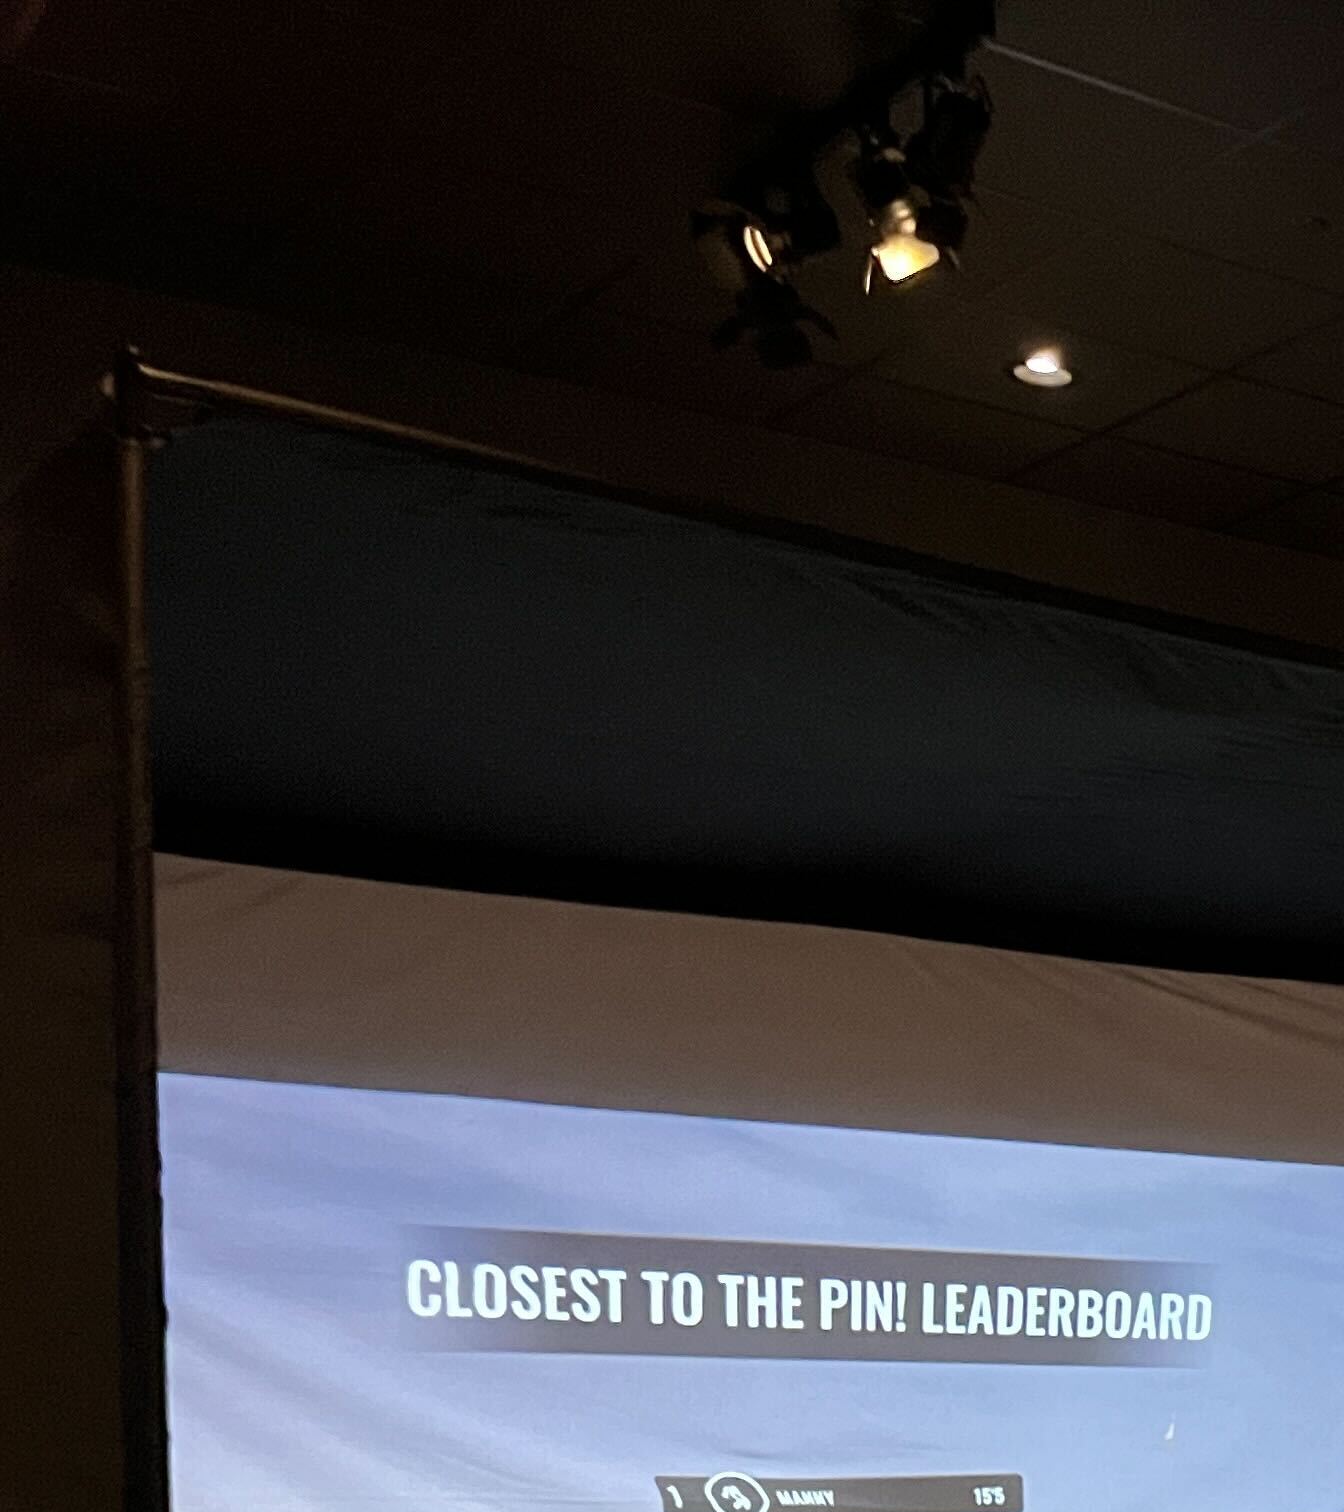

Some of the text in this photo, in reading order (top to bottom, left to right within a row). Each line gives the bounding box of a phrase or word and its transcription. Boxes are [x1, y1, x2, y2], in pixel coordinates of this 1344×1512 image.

[406, 1258, 1212, 1342] CLOSEST TO THE PIN! LEADERBOARD
[666, 1485, 683, 1509] 1
